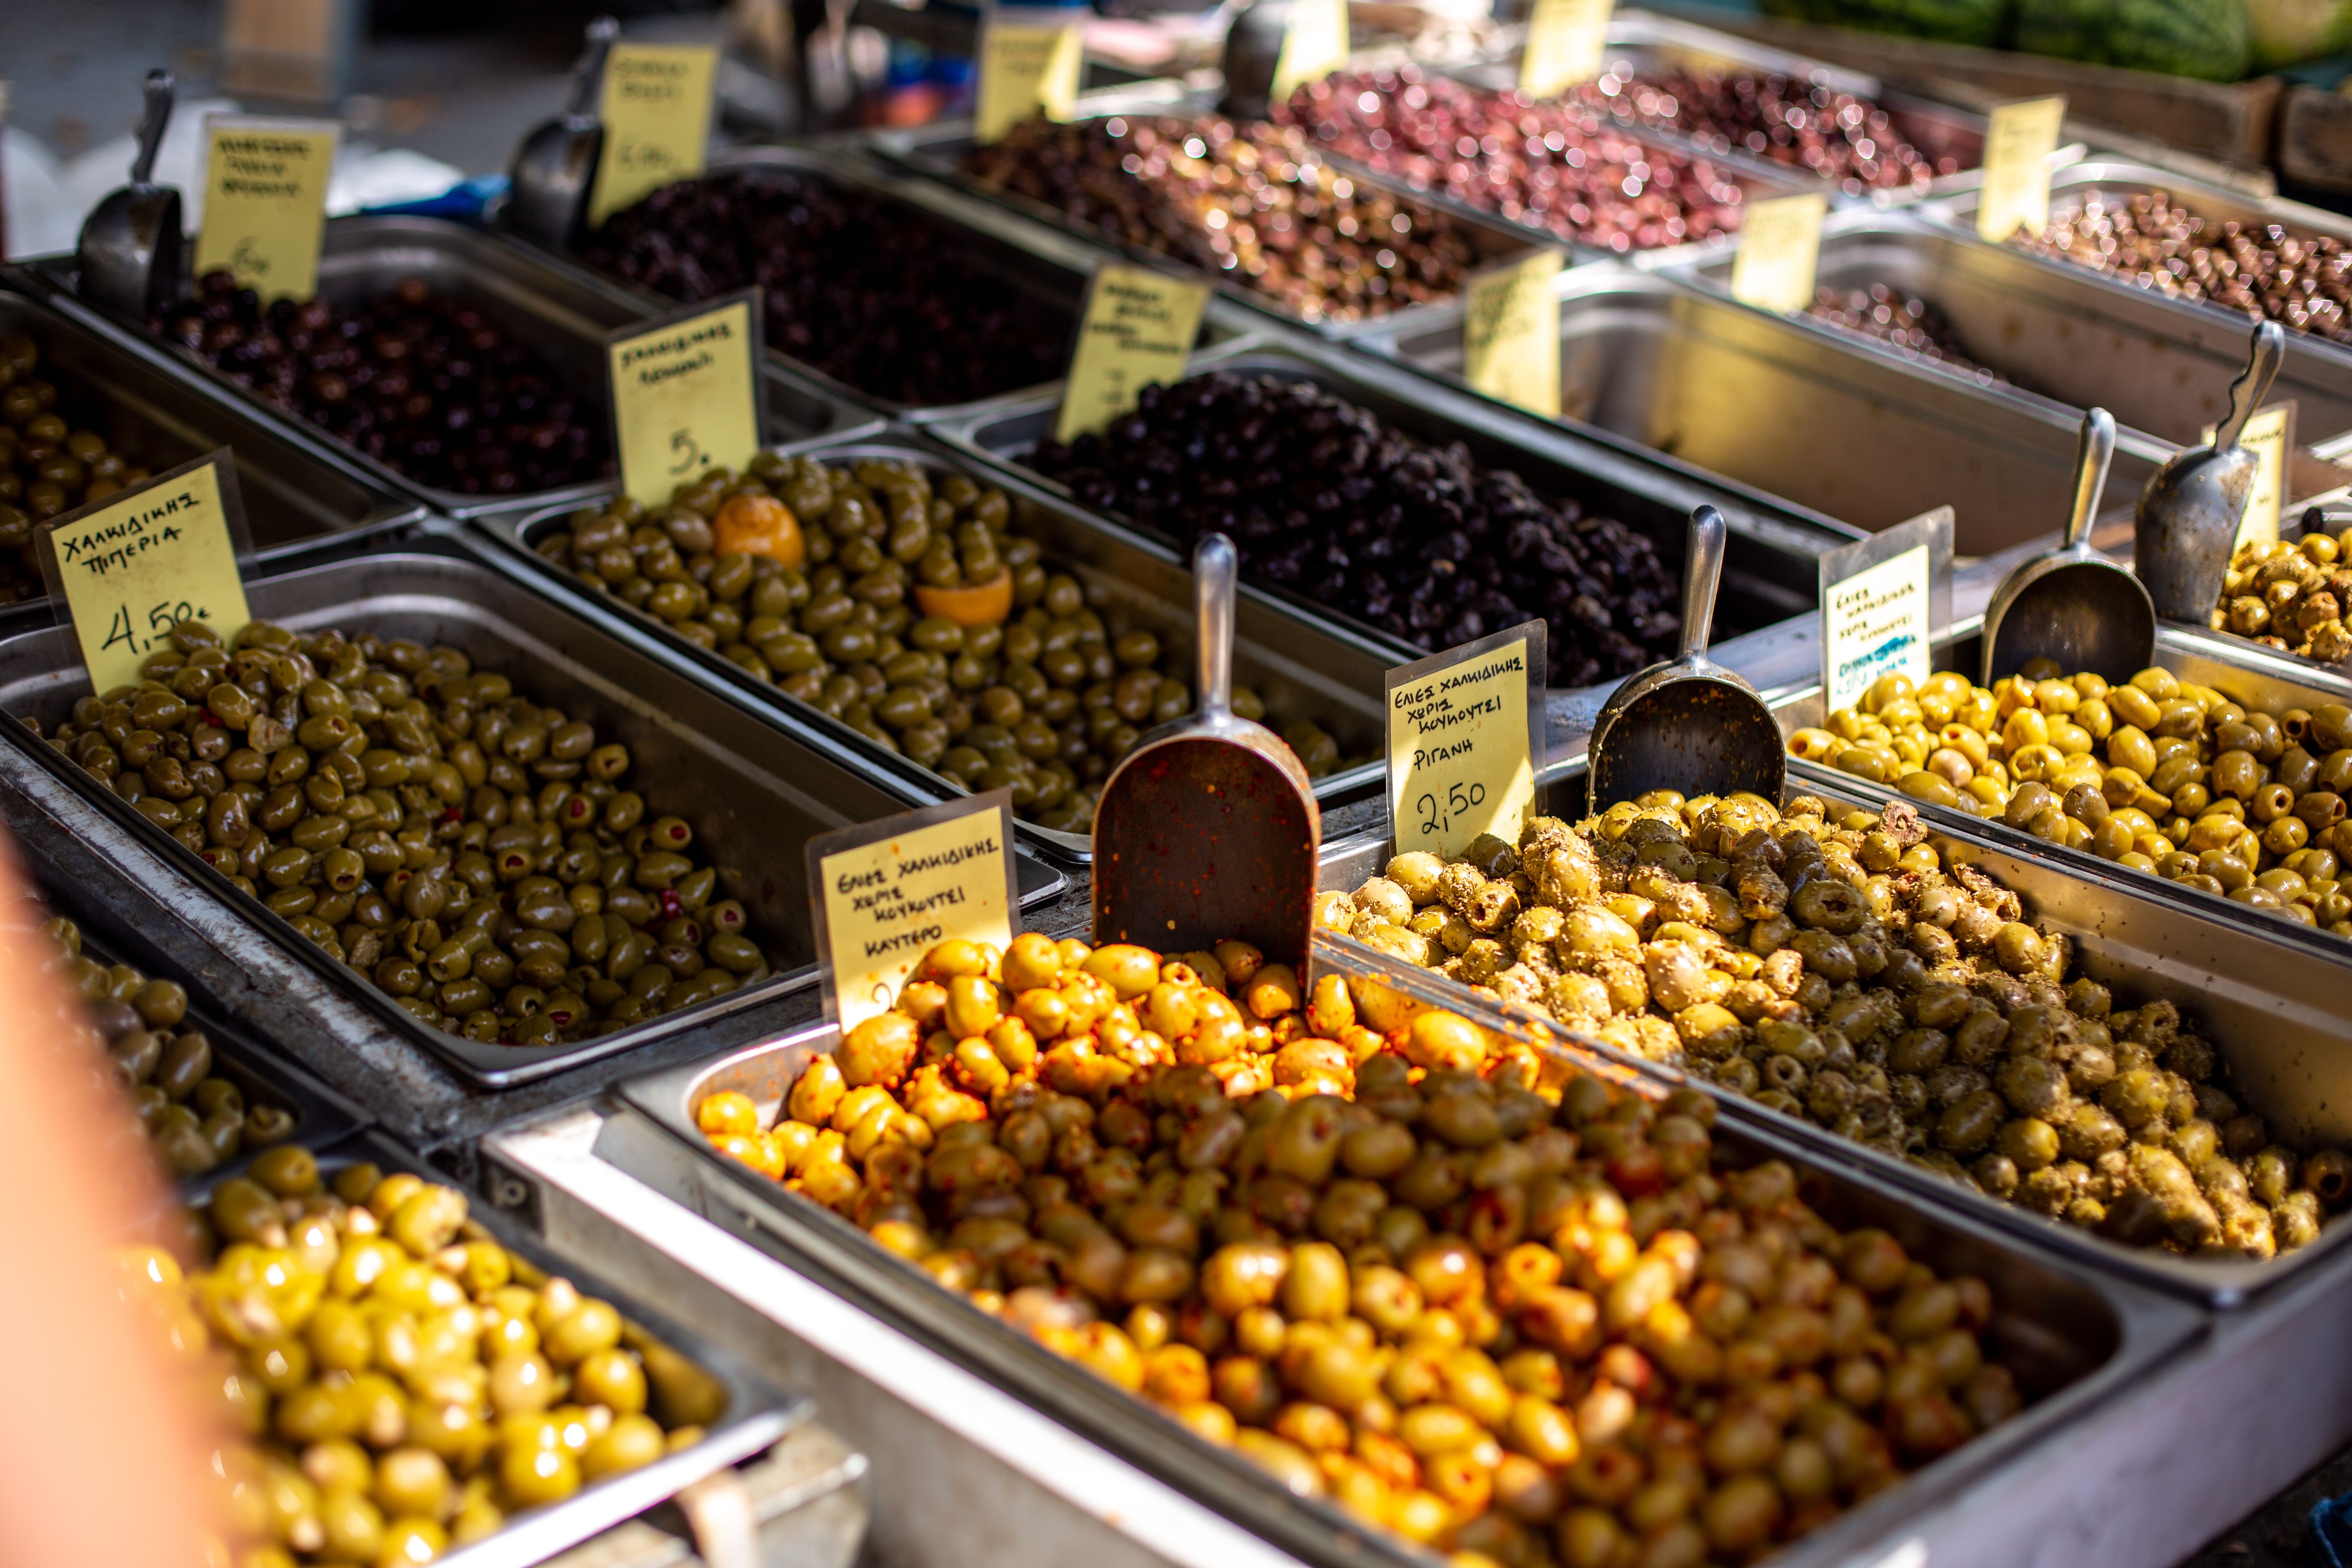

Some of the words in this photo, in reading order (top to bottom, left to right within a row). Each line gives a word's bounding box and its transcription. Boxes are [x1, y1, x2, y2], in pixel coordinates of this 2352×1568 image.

[62, 492, 200, 562] ΧΑΛΚΙΔΙΚΗΣ
[81, 526, 182, 574] ΠΙΠΕΡΙΑ
[1395, 686, 1435, 708] ΕΛΙΕΣ
[1440, 657, 1523, 693] ΧΑΛΚΙΔΙΚΗΣ
[1408, 698, 1453, 724] ΧΩΡΙΣ
[1419, 695, 1501, 734] ΚΟΥΚΟΥΤΣΙ
[1414, 739, 1473, 770] ΡΙΓΑΝΗ
[1417, 782, 1485, 834] 2,50
[838, 869, 887, 893] ΕΛΙΕΣ
[897, 838, 999, 878] ΧΑΛΚΙΔΙΚΗΣ
[864, 925, 942, 958] ΚΑΥΤΕΡΟ
